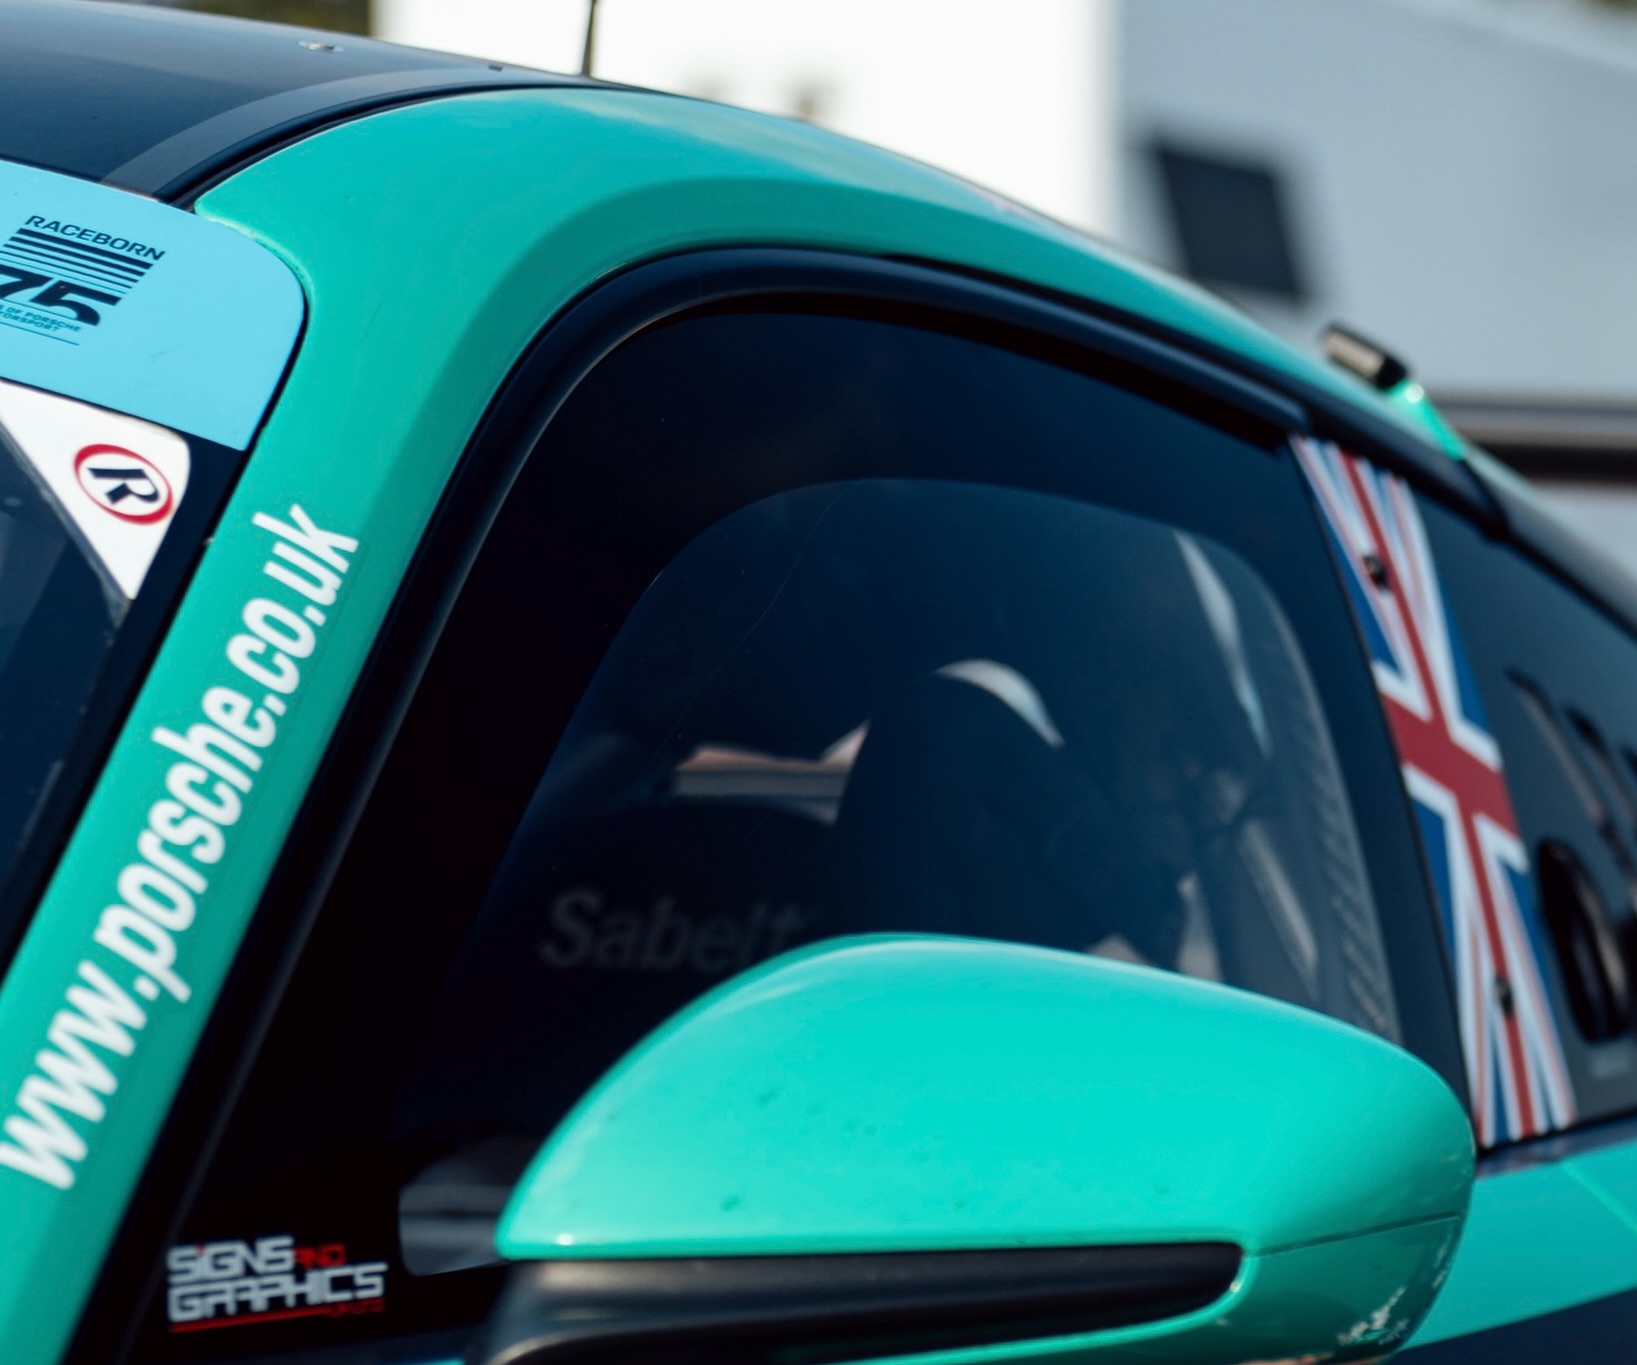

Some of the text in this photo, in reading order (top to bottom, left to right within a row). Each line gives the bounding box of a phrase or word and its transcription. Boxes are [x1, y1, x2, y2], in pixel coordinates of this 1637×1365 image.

[25, 215, 166, 261] RACEBORN
[0, 263, 122, 326] 75
[25, 311, 82, 332] PORSCHE
[0, 504, 359, 1192] www.porsche.co.uk
[167, 1235, 294, 1284] SIGNS
[167, 1262, 388, 1322] GRAPHICS
